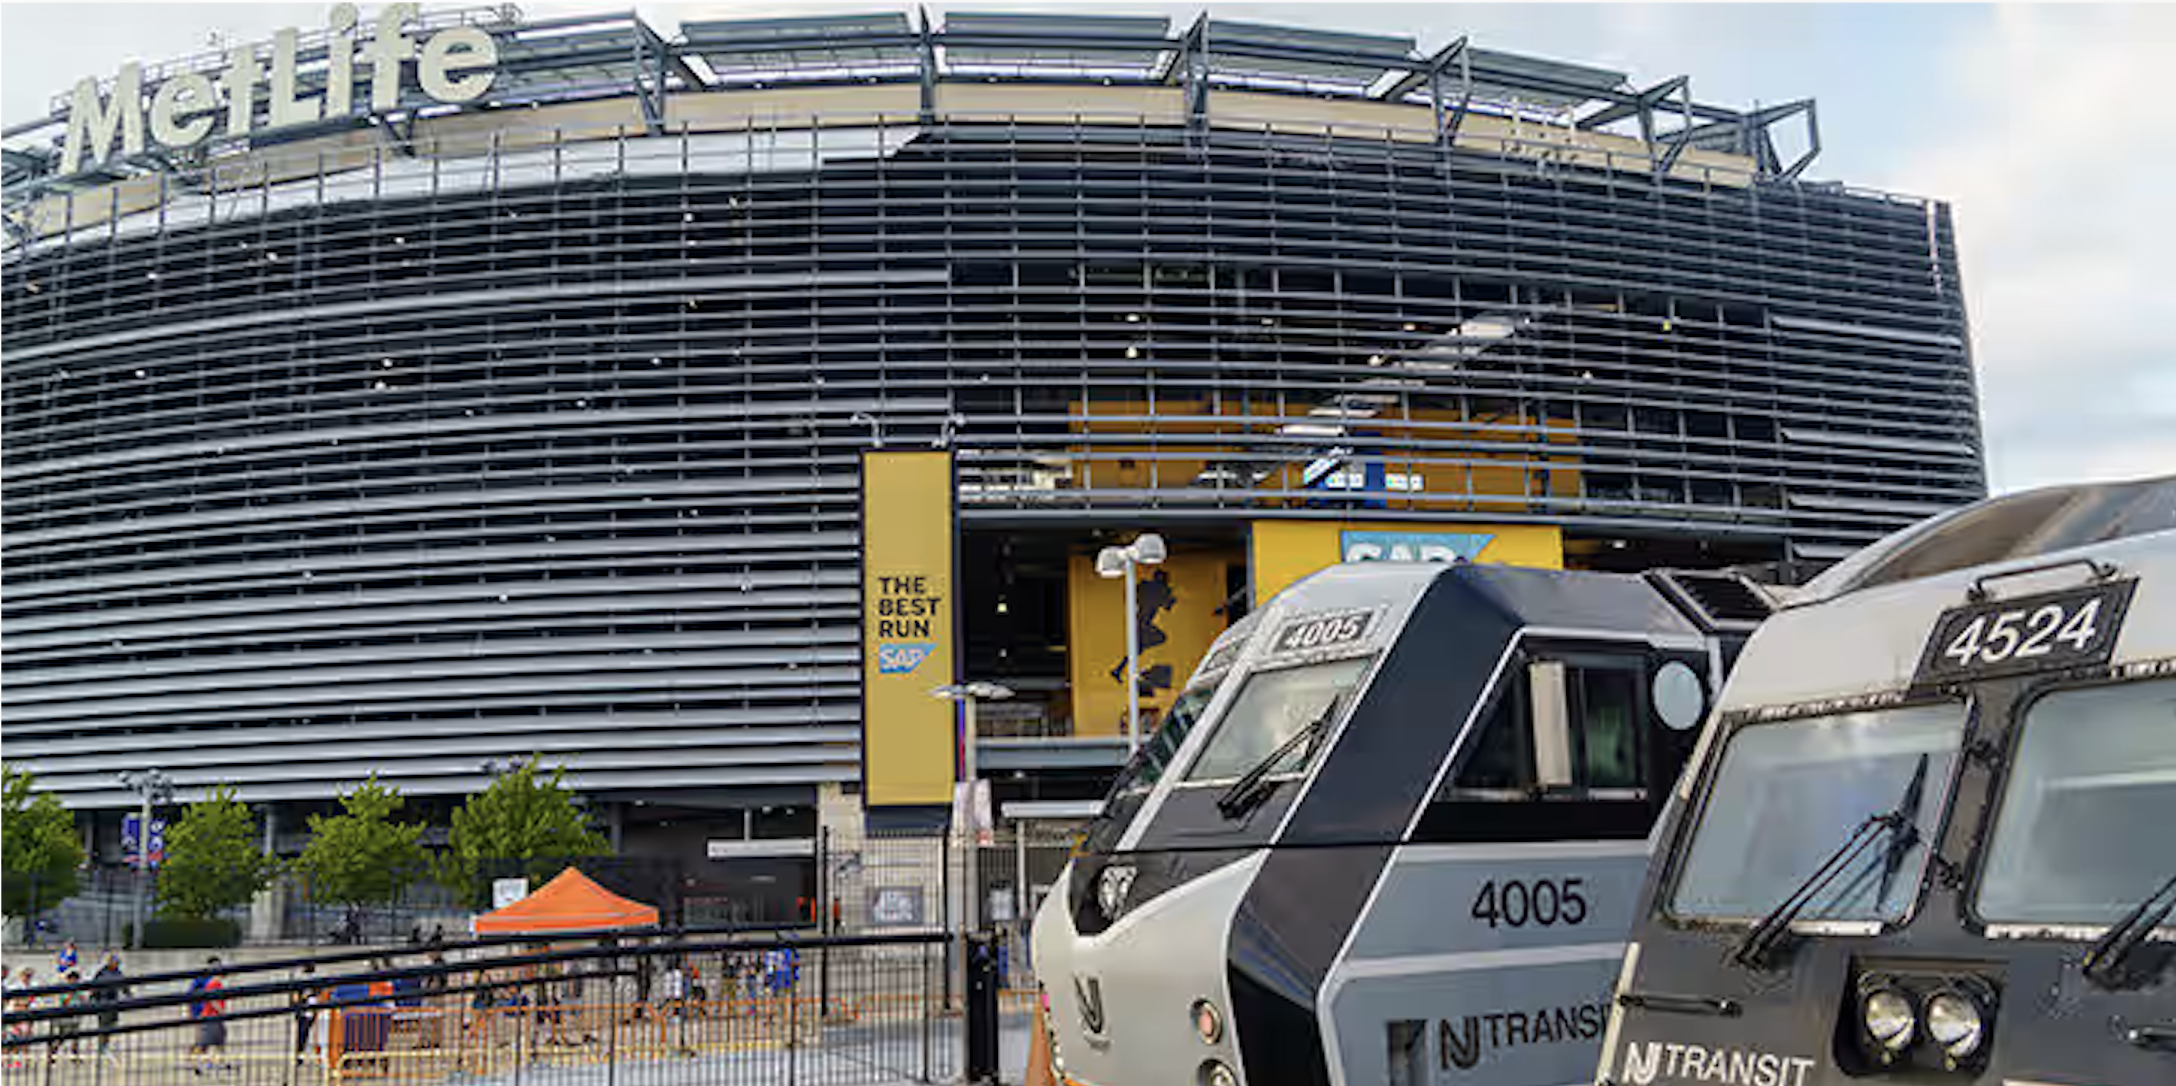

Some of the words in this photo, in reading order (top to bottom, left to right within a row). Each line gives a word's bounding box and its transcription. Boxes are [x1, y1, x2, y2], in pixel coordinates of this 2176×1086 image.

[58, 3, 500, 175] MetLife
[878, 577, 925, 594] THE
[878, 598, 941, 616] BEST
[878, 620, 929, 637] RUN
[1284, 616, 1359, 648] 4005
[1945, 598, 2101, 666] 4524
[1471, 879, 1586, 928] 4005
[1438, 1015, 1480, 1070] NJ
[1484, 1003, 1612, 1048] TRANSI
[1621, 1042, 1663, 1085] NJ
[1666, 1044, 1816, 1086] TRANSIT
